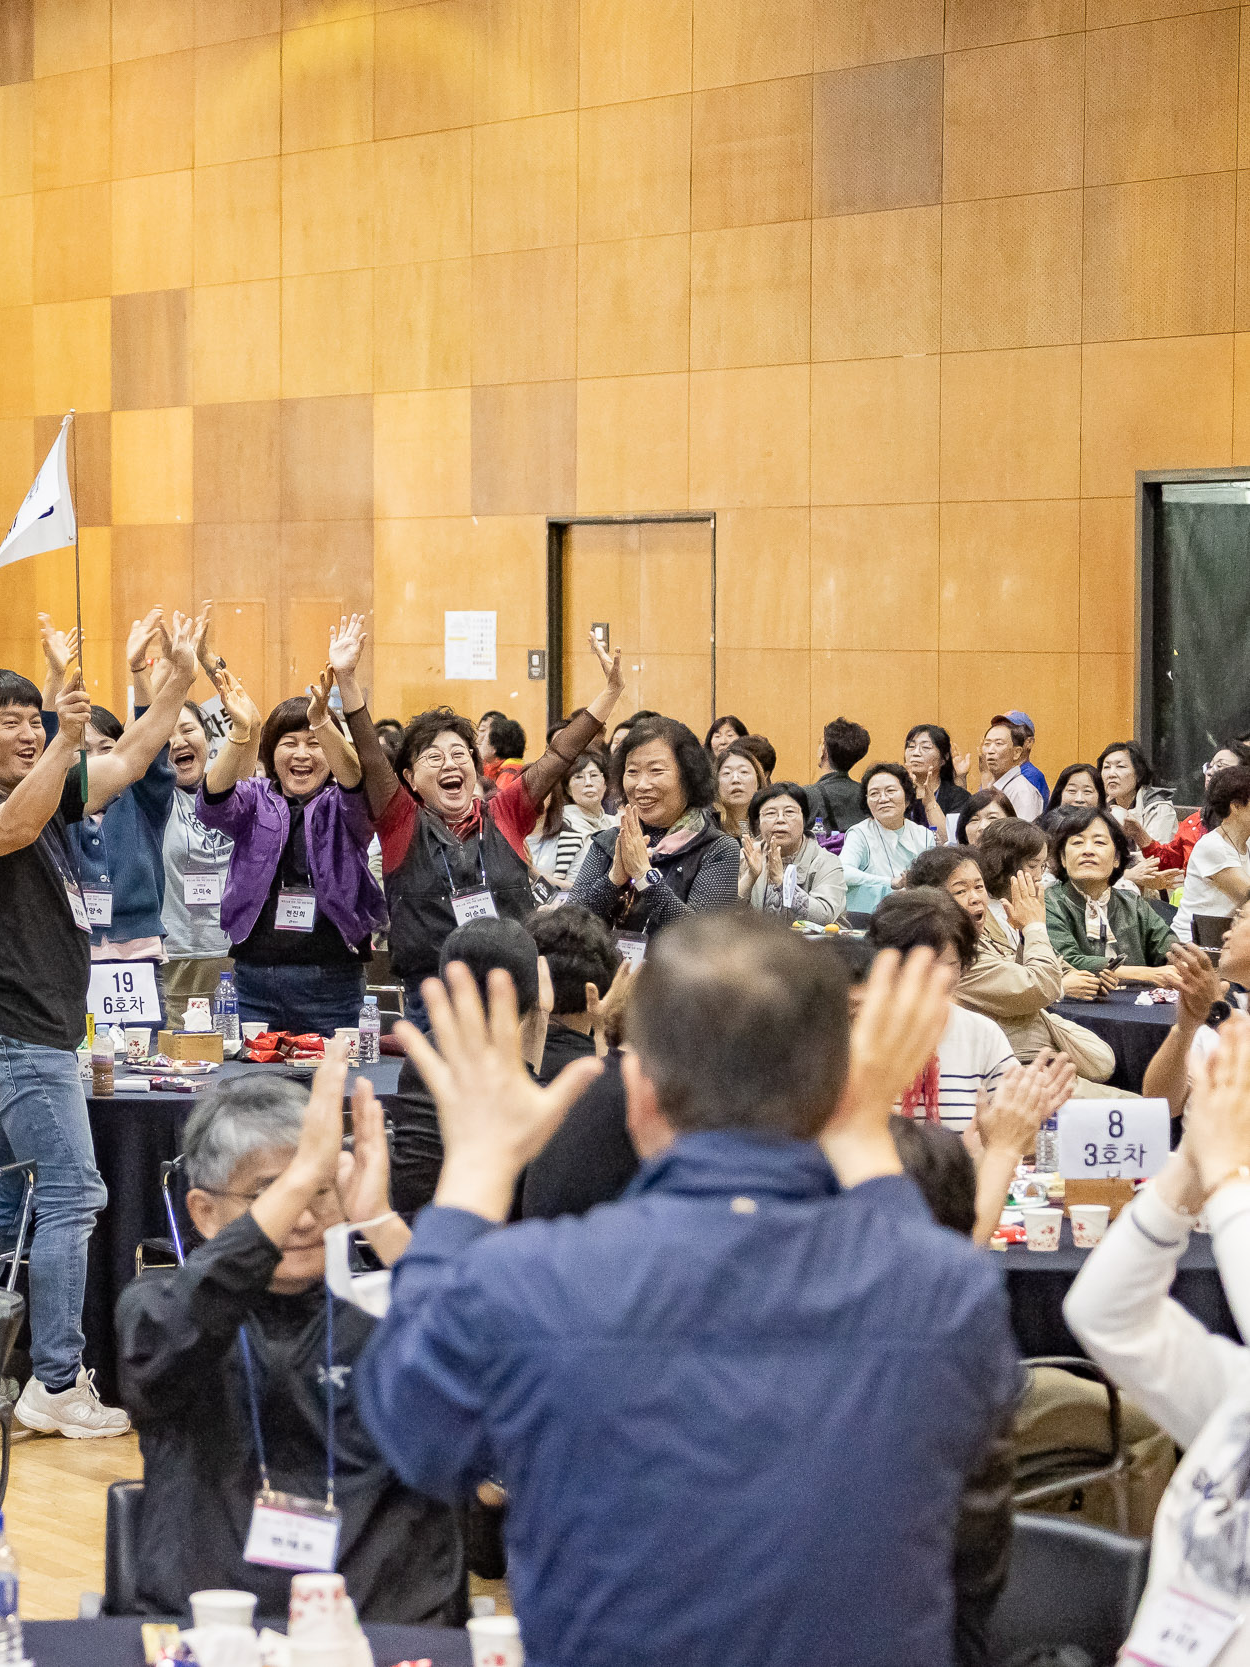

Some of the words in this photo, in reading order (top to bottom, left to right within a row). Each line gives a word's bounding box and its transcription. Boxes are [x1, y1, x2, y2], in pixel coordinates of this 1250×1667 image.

[112, 971, 134, 993] 19
[103, 996, 145, 1015] 6호차
[1108, 1109, 1124, 1138] 8
[1084, 1143, 1148, 1168] 3호차
